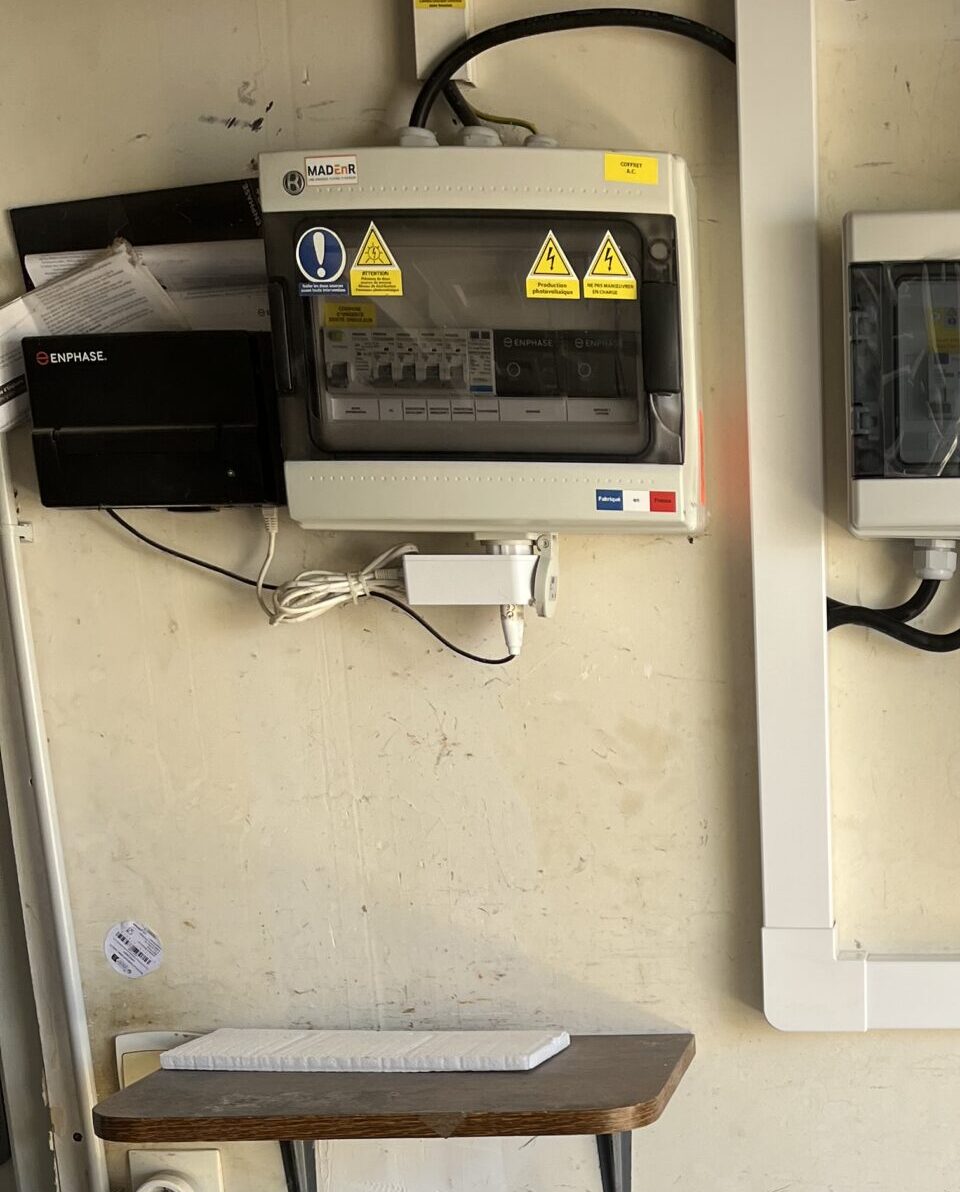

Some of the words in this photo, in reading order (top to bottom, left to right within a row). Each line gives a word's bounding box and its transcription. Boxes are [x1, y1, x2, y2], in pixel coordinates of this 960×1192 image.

[307, 163, 356, 176] MADEnR
[514, 337, 553, 346] ENPHASE
[50, 351, 105, 363] ENPHASE
